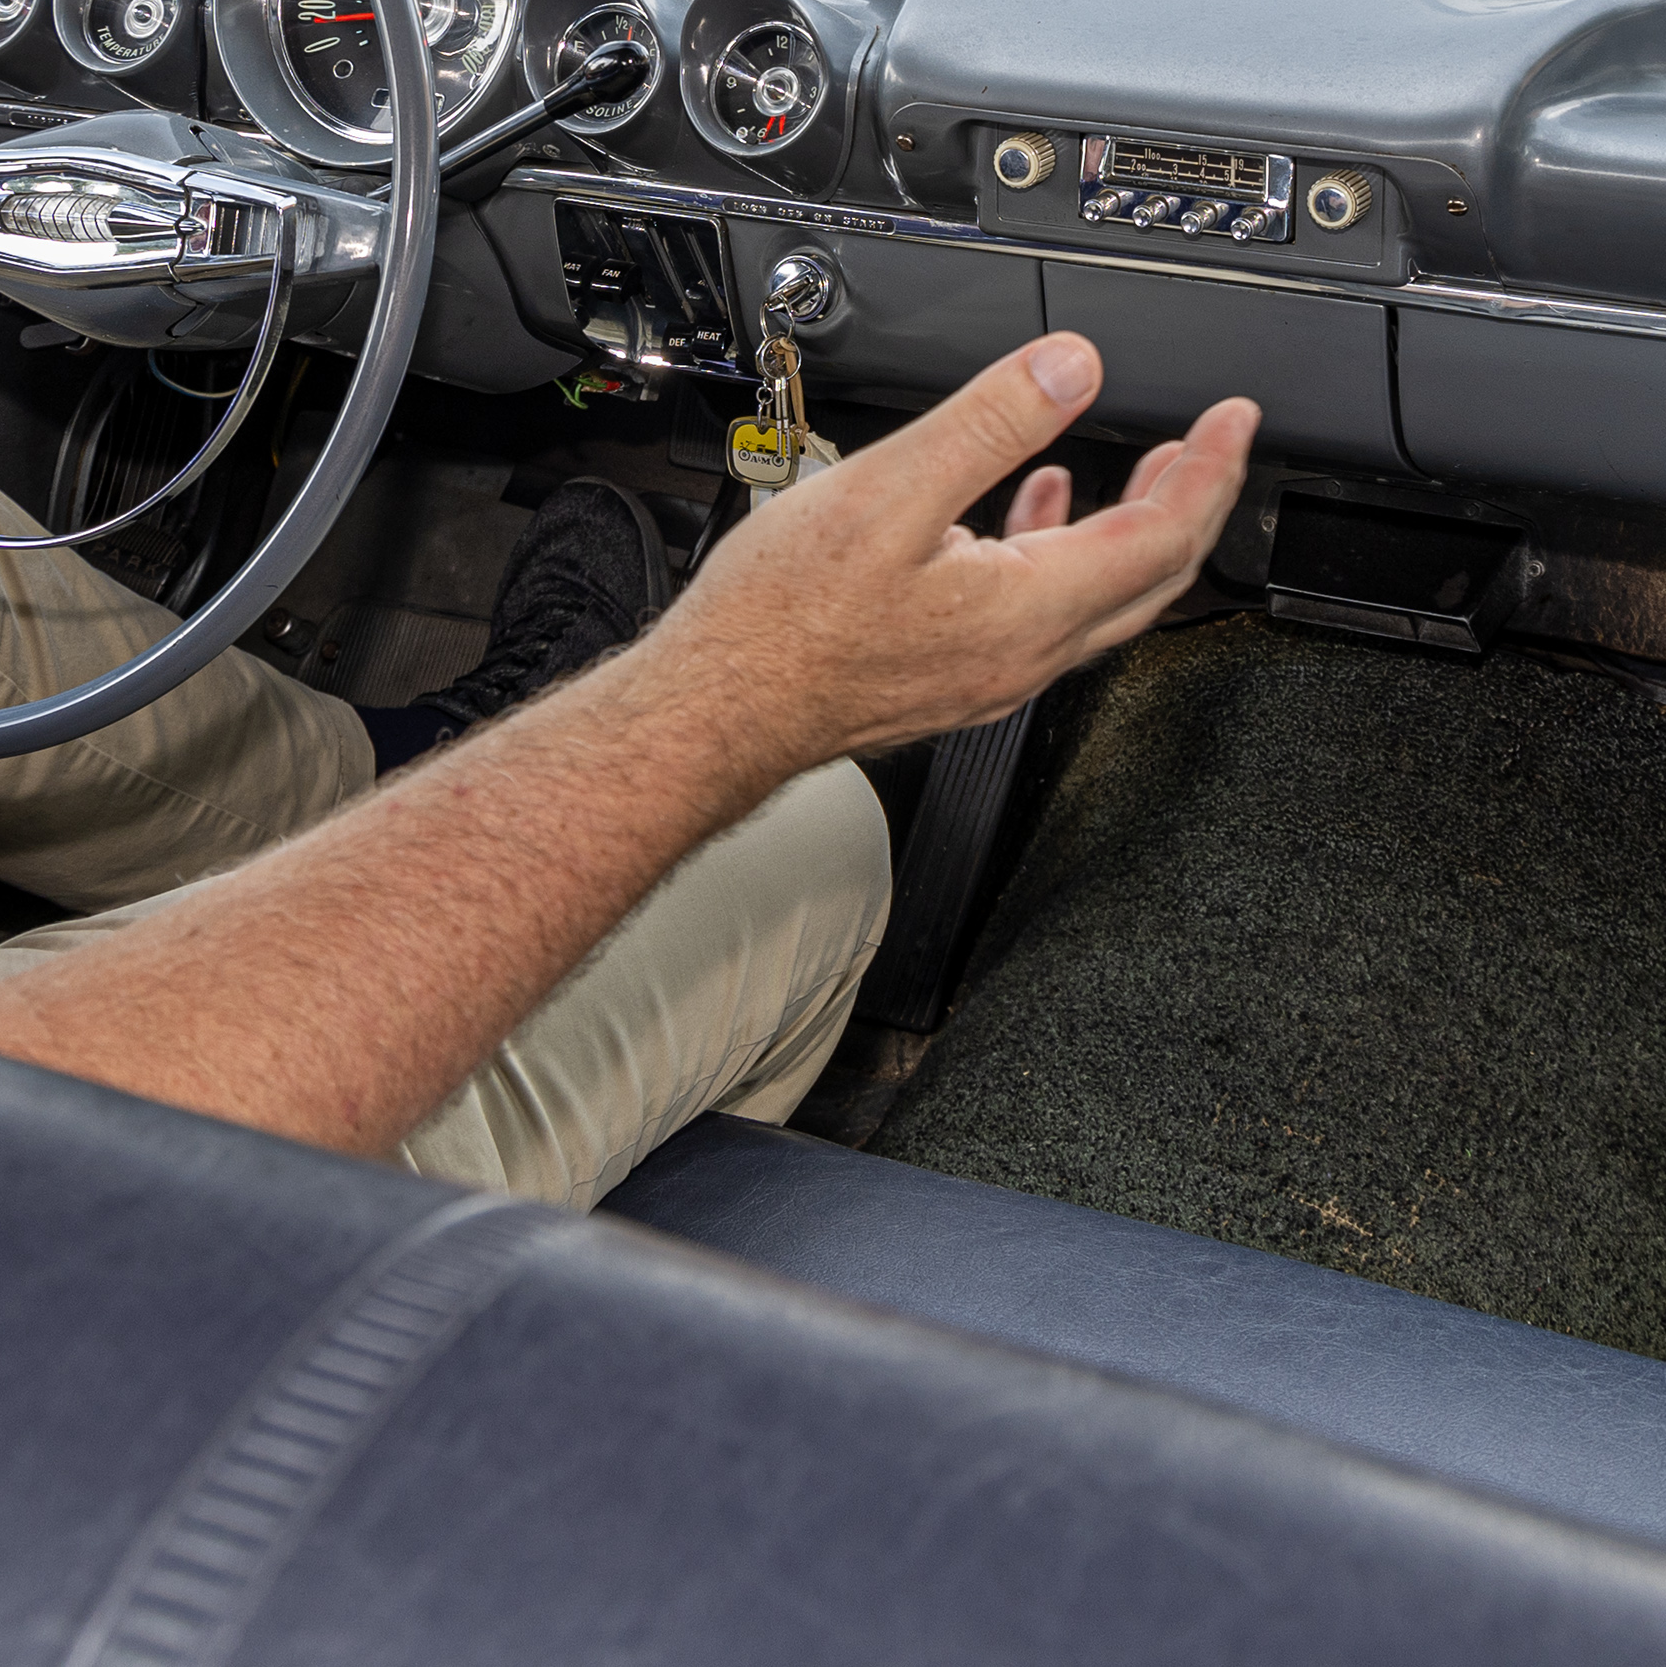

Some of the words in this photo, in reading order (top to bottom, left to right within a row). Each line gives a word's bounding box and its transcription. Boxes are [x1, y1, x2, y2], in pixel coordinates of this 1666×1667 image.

[297, 0, 336, 21] 20
[304, 37, 340, 53] 0
[775, 35, 789, 50] 12
[726, 77, 737, 90] 9
[809, 86, 817, 99] 3
[585, 100, 633, 118] SOLINE
[1198, 154, 1208, 167] 15
[843, 216, 886, 230] START
[601, 268, 621, 278] FAN
[668, 337, 686, 347] DEF
[697, 330, 722, 342] HEAT
